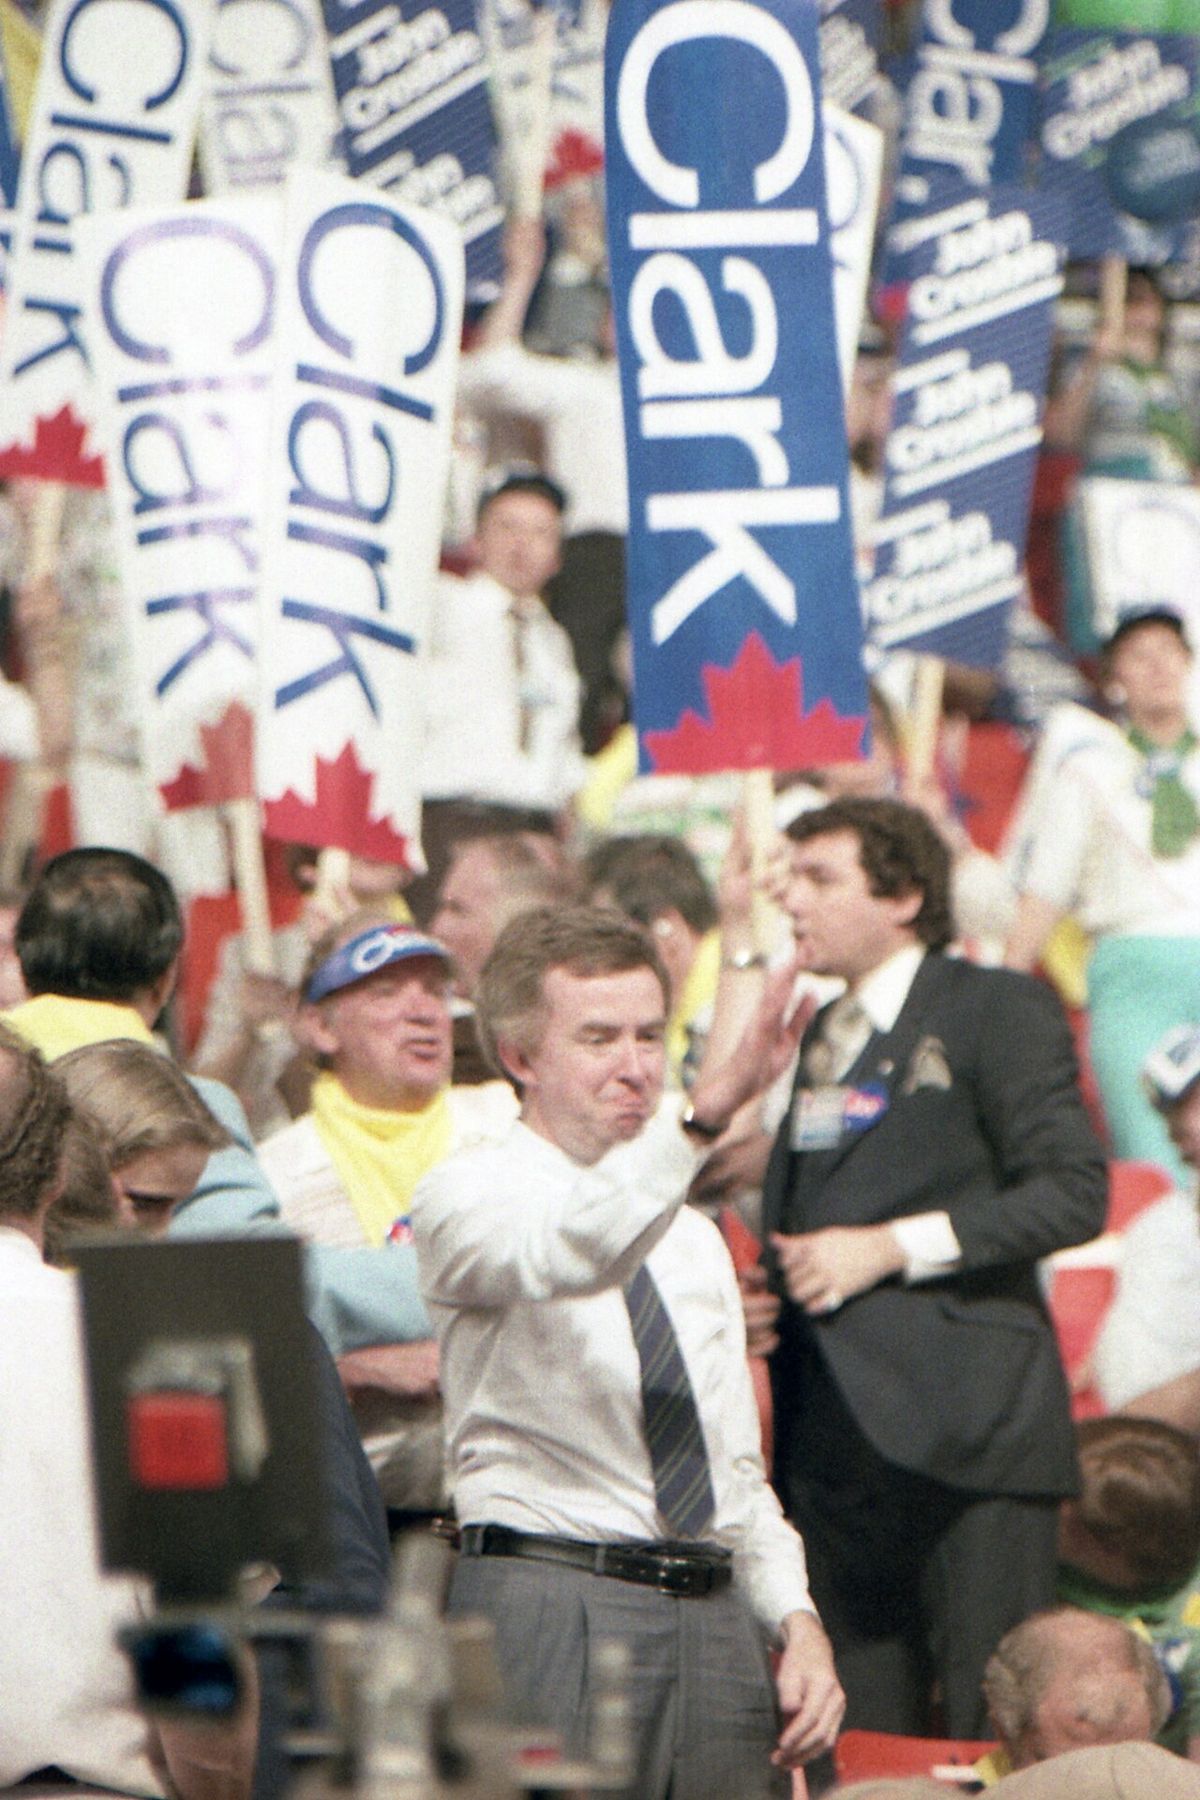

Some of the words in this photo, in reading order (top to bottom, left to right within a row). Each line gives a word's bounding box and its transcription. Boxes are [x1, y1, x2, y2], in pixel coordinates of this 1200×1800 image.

[14, 0, 189, 378] Clak
[617, 0, 841, 647] Clark
[100, 216, 276, 699] Clark
[274, 202, 447, 724] Clark
